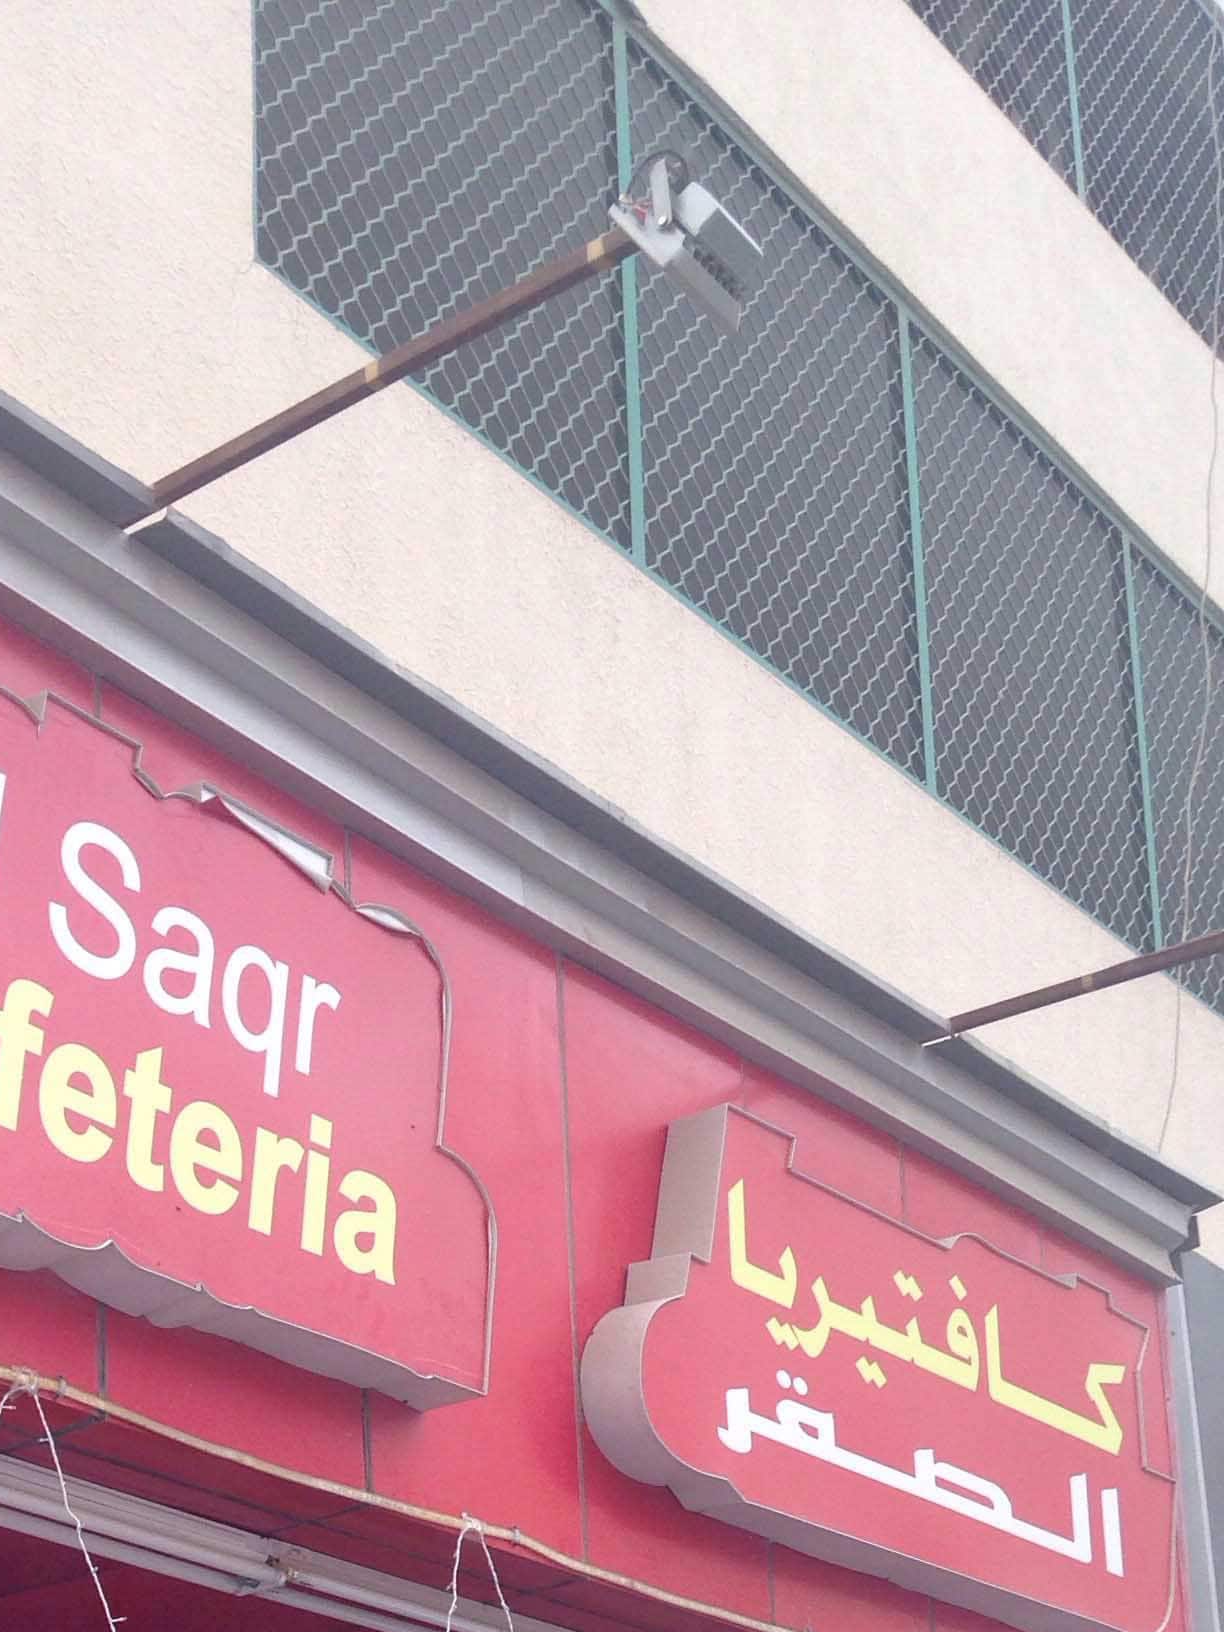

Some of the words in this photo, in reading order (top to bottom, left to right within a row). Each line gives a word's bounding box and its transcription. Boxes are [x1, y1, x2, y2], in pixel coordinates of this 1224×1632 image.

[48, 821, 341, 1098] Saqr
[727, 1178, 1126, 1456] كافتيريا
[717, 1369, 1124, 1578] الصقر
